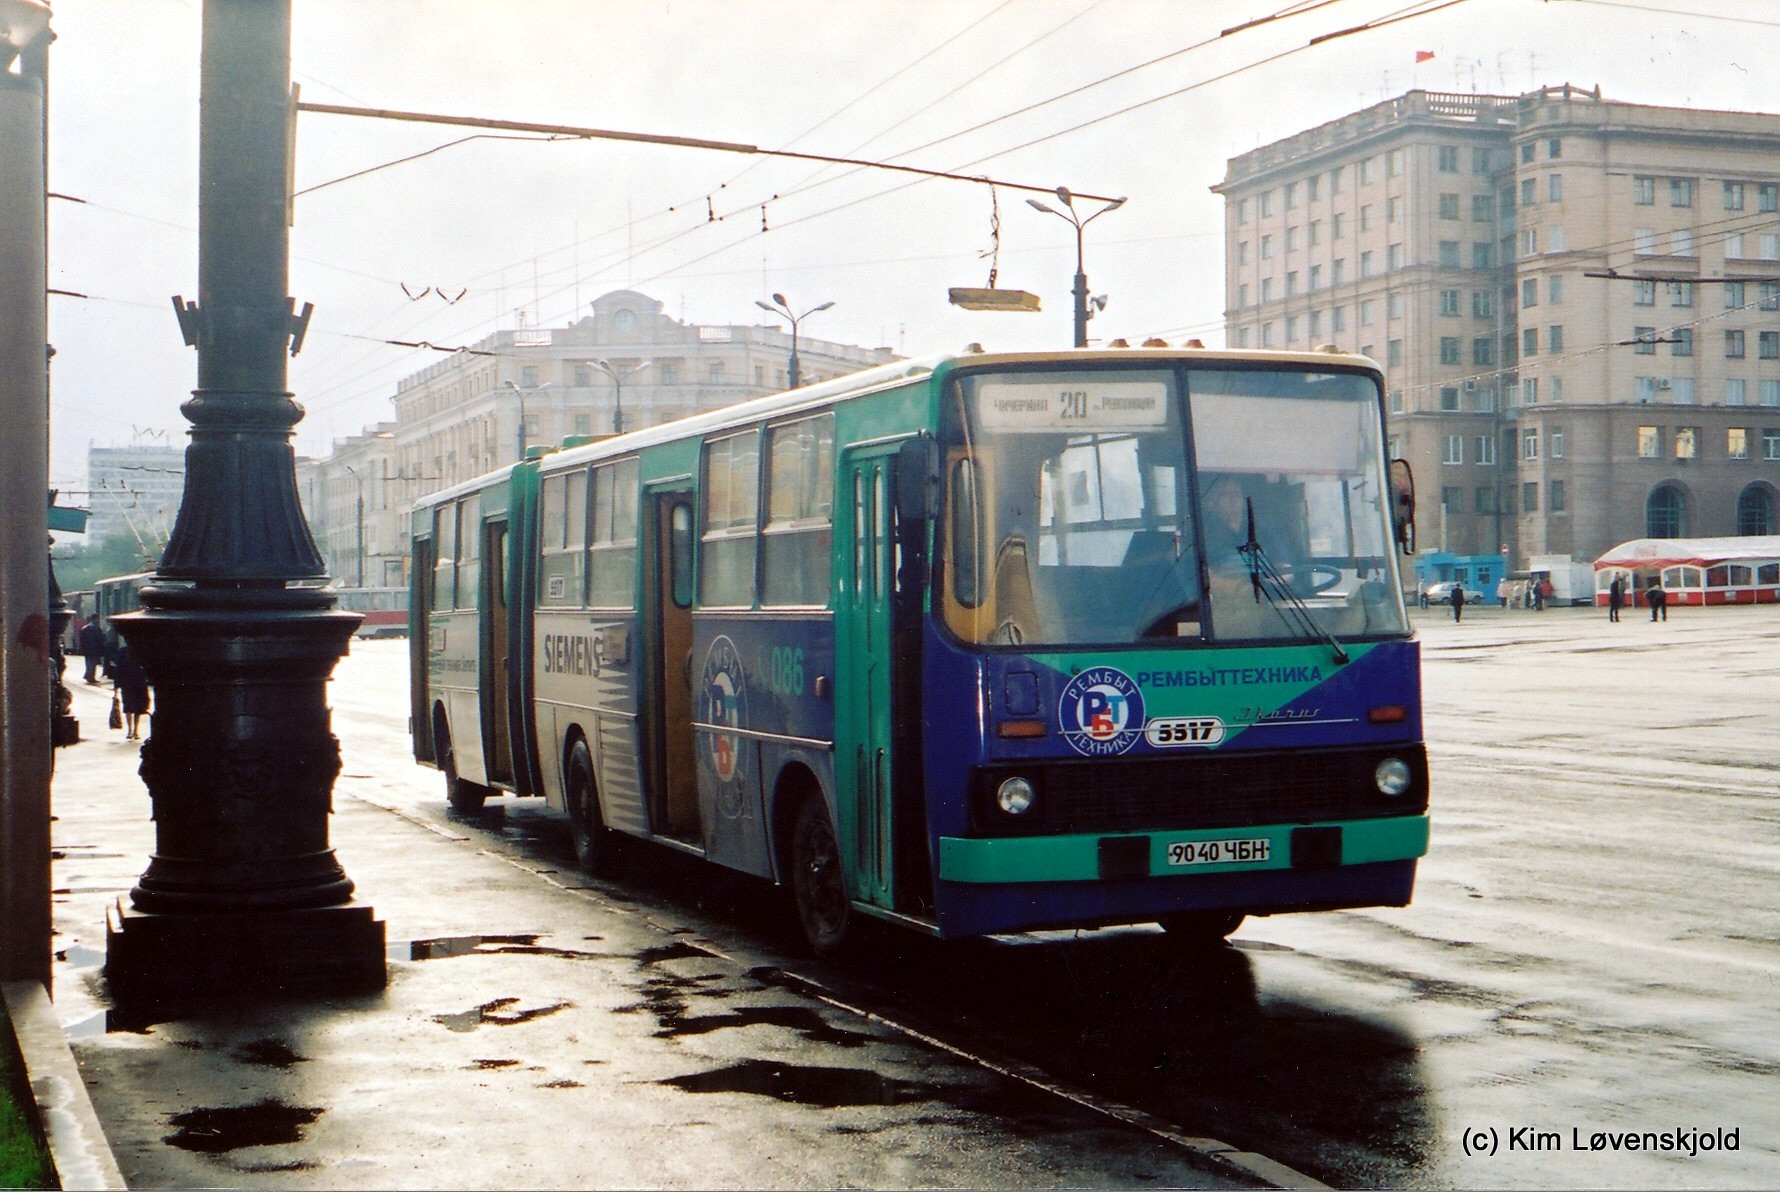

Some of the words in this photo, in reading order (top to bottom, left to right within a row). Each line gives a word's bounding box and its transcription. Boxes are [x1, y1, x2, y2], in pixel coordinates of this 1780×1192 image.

[1060, 391, 1087, 419] 20
[544, 633, 604, 679] SIEMENS
[771, 647, 804, 697] 086
[1137, 665, 1323, 688] РЕМБЫТТЕХНИКА
[1068, 671, 1137, 700] РЕМБЫТ
[1072, 730, 1136, 754] ТЕХНИКА
[1158, 721, 1215, 742] 5517
[1225, 841, 1265, 860] ЧБН
